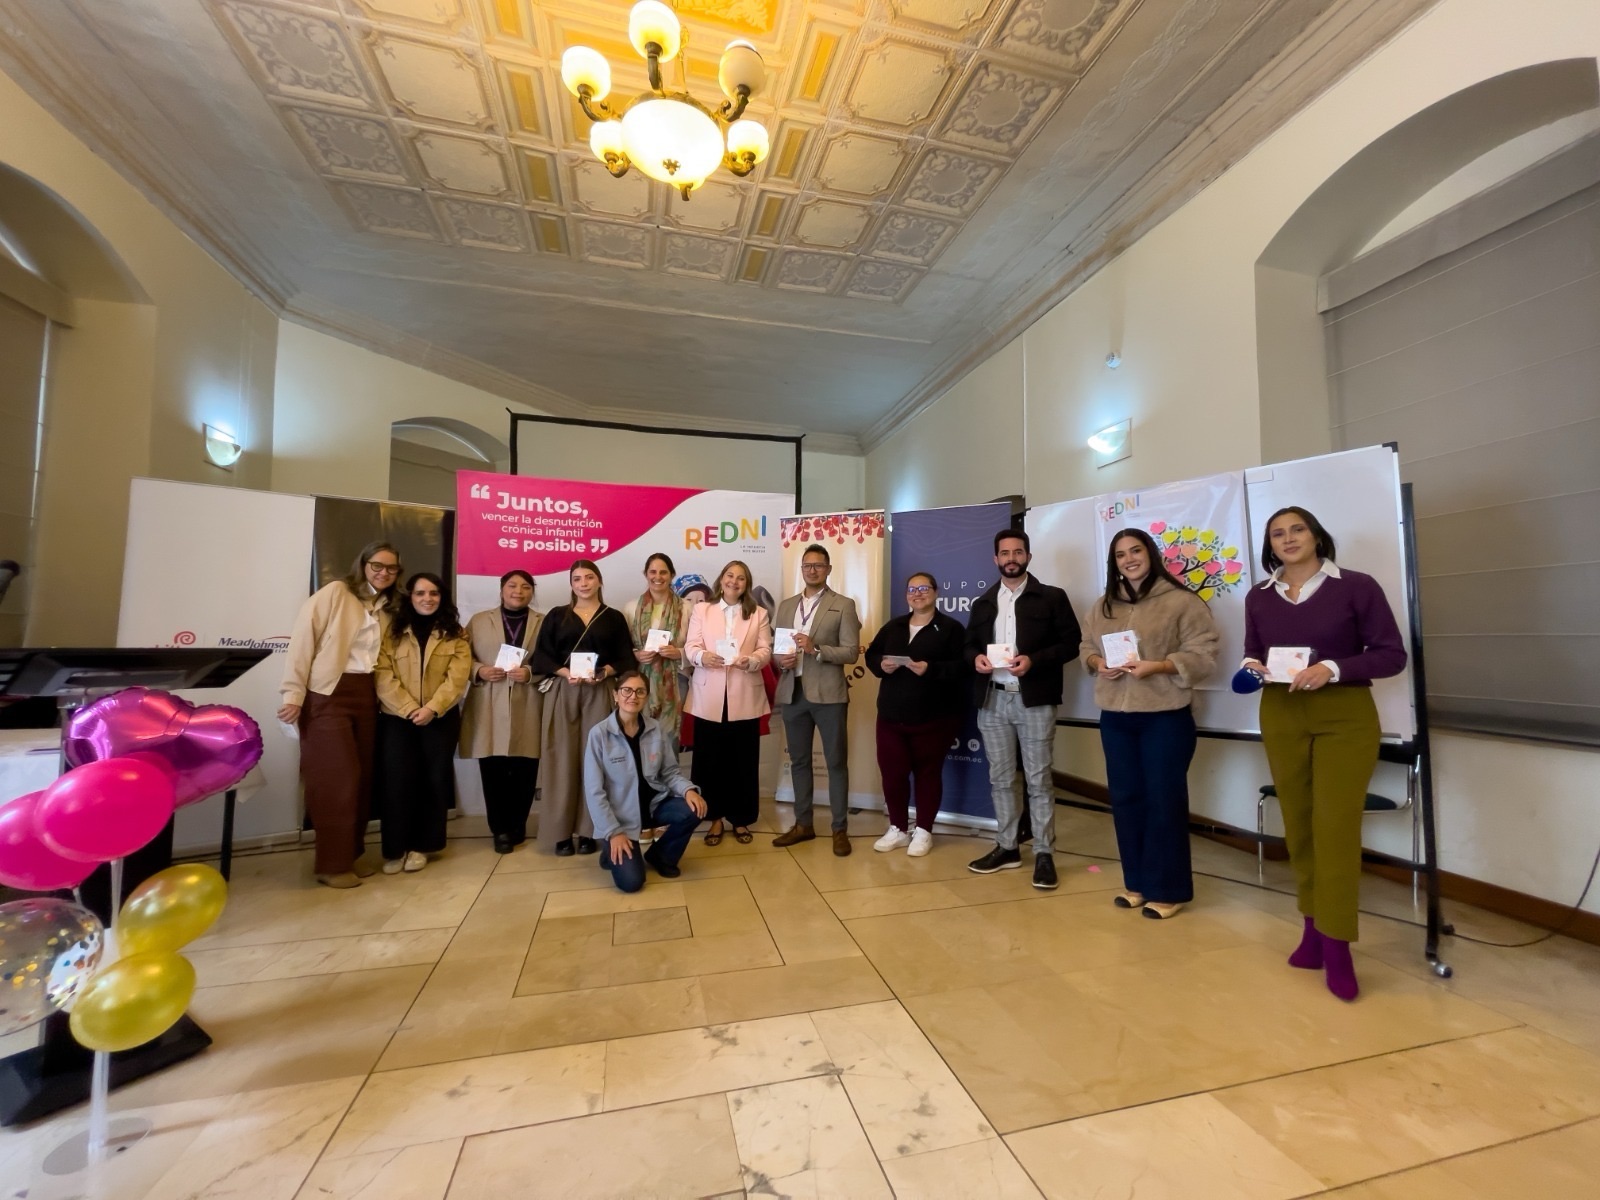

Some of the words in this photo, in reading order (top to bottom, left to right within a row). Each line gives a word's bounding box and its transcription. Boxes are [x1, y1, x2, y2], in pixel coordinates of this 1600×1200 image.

[496, 491, 589, 518] Juntos,
[1100, 494, 1140, 522] REDNI
[481, 512, 519, 523] vencer
[521, 514, 531, 524] la
[534, 516, 603, 529] desnutrición
[501, 524, 543, 536] crónica
[545, 527, 584, 538] infantil
[685, 515, 766, 550] REDNI
[498, 538, 518, 549] es
[523, 539, 586, 553] posible
[943, 580, 986, 590] UPO
[909, 596, 980, 613] TUR
